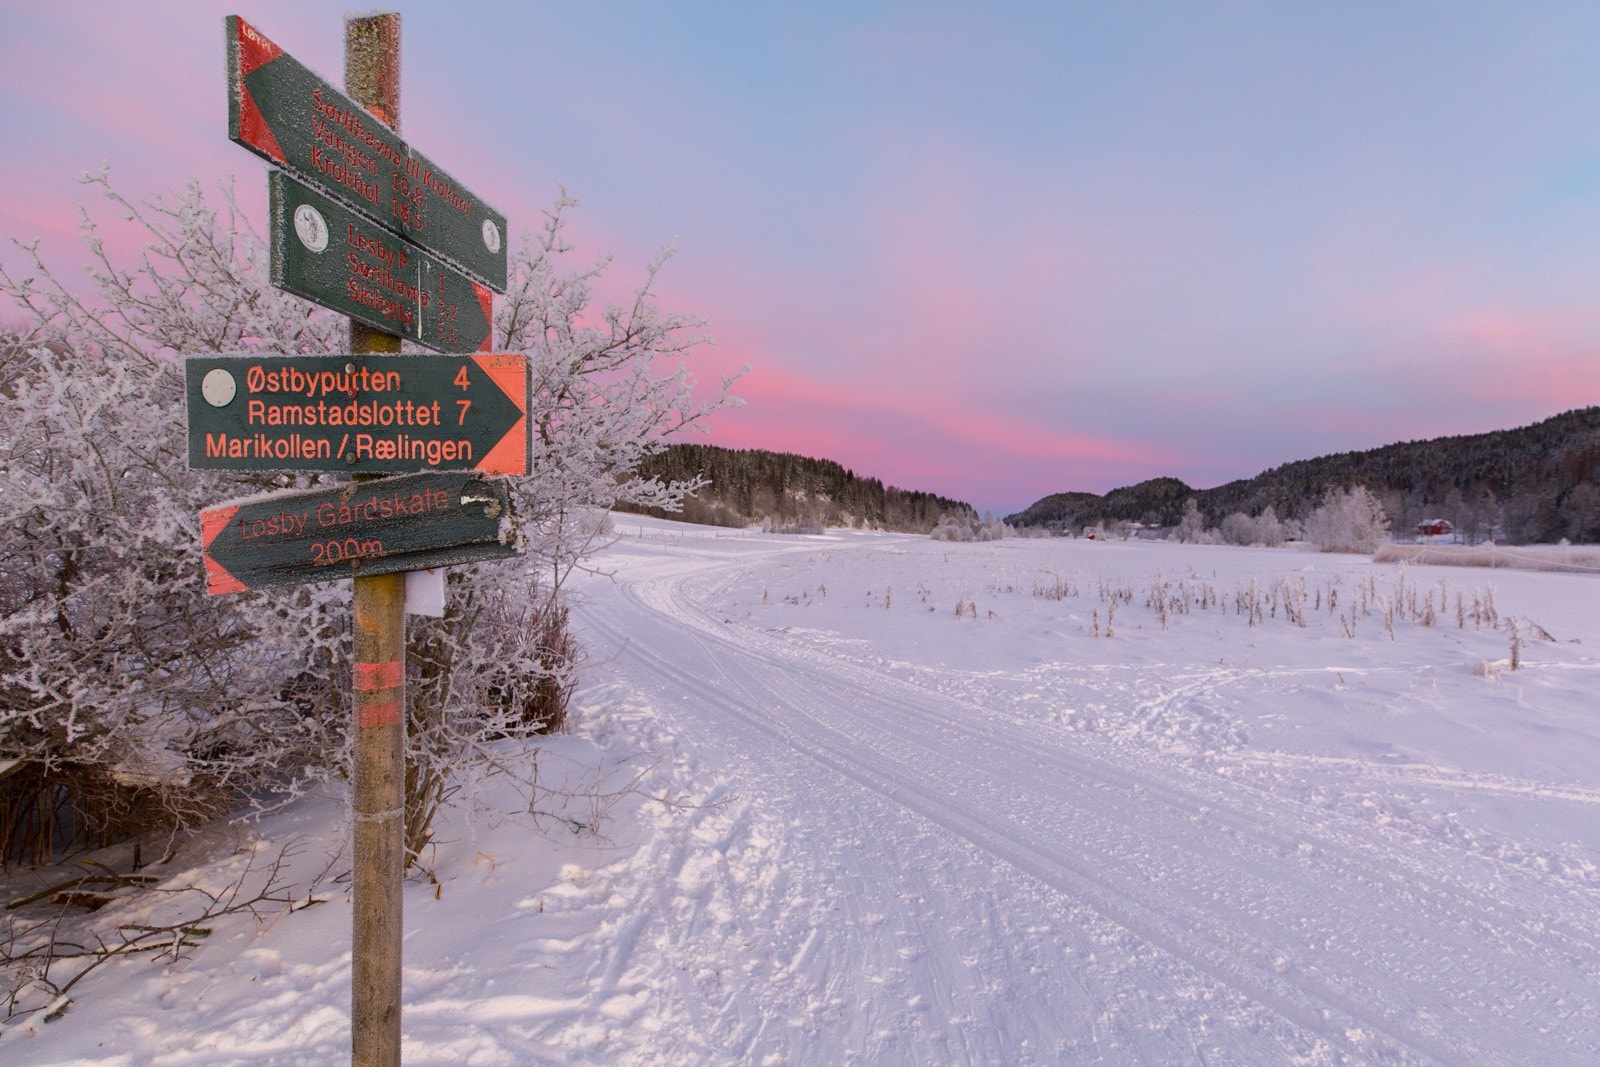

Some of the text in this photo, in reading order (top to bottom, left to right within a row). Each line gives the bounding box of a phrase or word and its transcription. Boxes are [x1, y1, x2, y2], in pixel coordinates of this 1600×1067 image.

[312, 88, 401, 166] Sørlihavna
[405, 157, 421, 180] til
[312, 114, 377, 176] Vangen
[311, 145, 379, 205] Krokhol
[399, 250, 408, 270] P
[438, 274, 445, 292] 1
[246, 364, 471, 398] Østbyputten 4
[248, 399, 472, 426] Ramstadslottet 7
[205, 433, 330, 459] Marikollen
[356, 434, 472, 466] Rælingen
[242, 511, 307, 539] Losby
[310, 537, 383, 567] 200m
